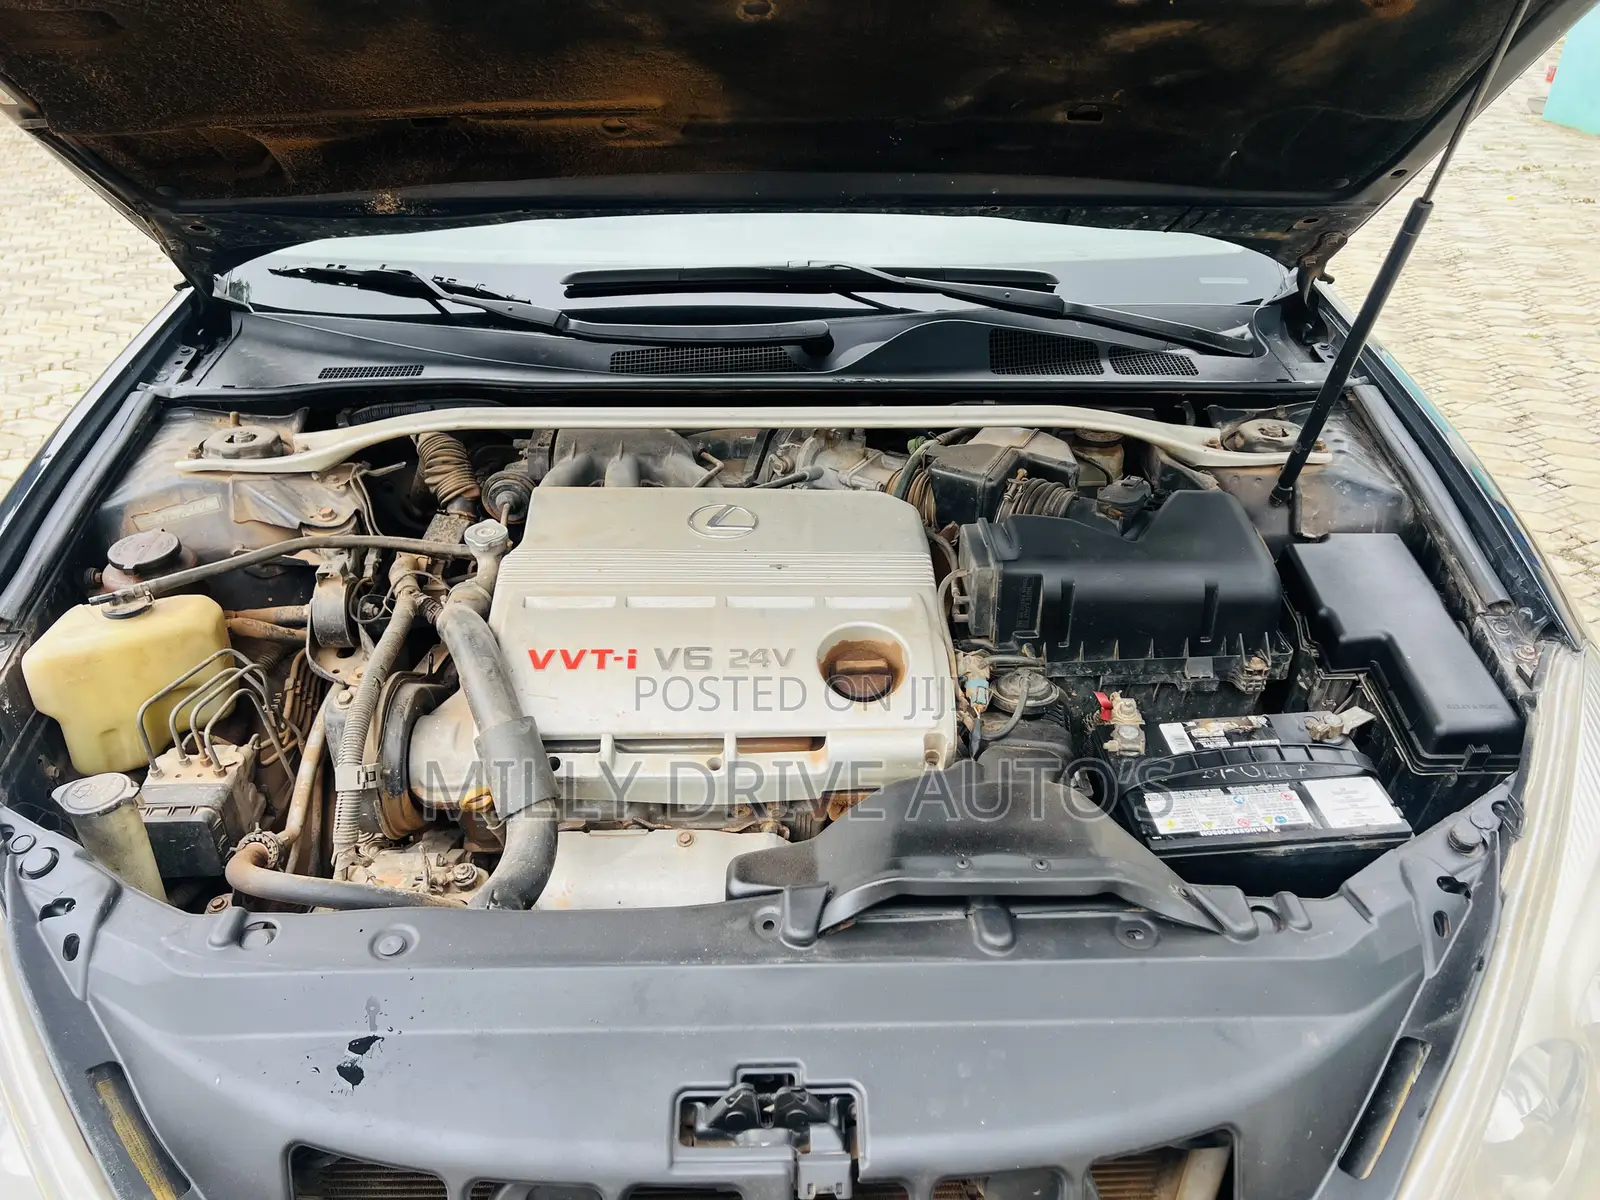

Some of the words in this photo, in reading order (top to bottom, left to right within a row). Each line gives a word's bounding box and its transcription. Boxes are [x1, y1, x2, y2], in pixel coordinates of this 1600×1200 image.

[527, 647, 638, 671] VVT-i
[653, 646, 713, 671] V6
[728, 647, 796, 670] 24V
